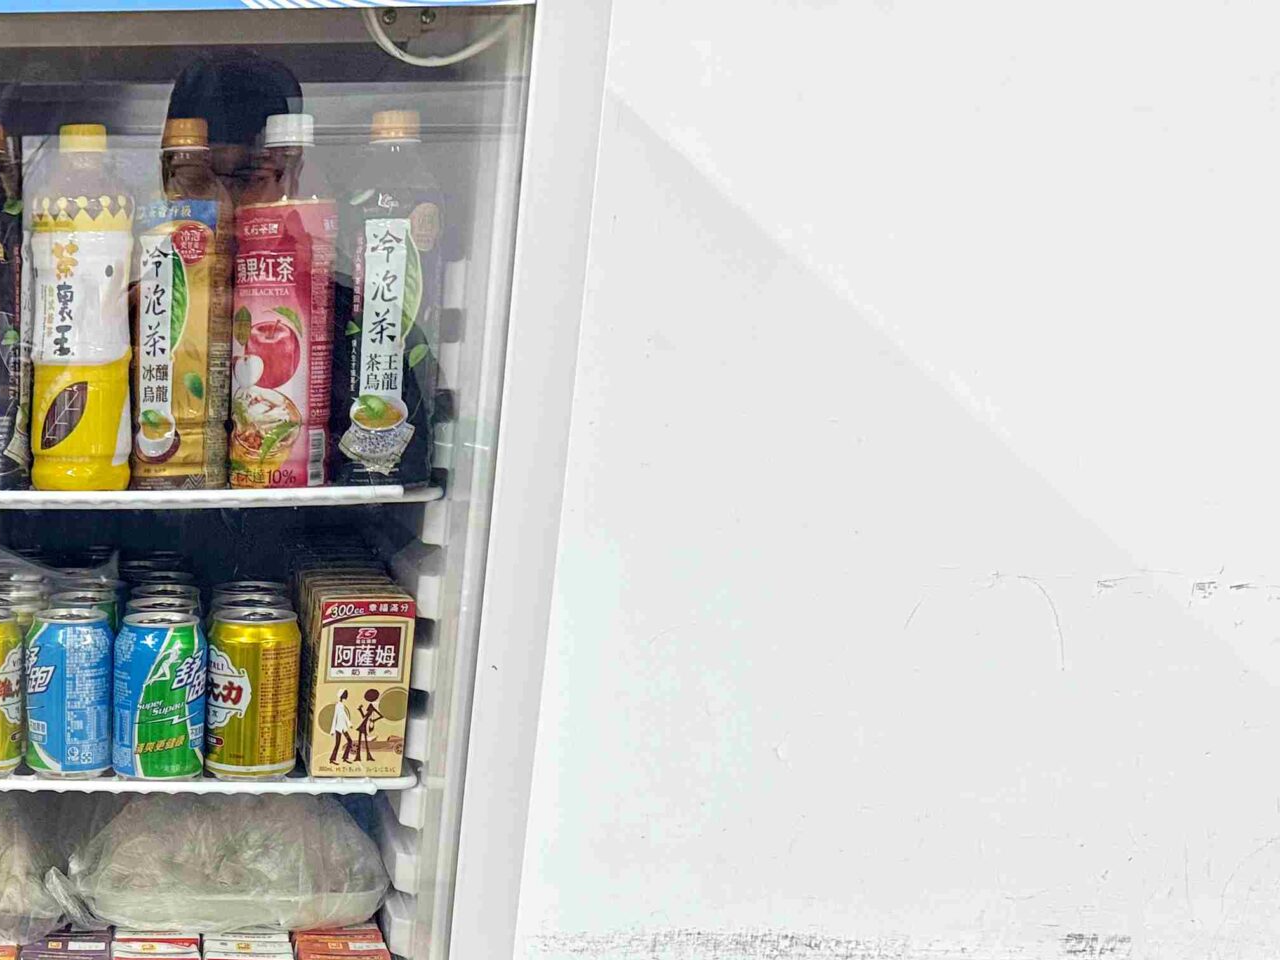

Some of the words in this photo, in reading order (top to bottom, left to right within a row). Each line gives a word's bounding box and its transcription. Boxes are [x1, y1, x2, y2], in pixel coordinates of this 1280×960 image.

[141, 246, 170, 357] 冷泡茶
[369, 230, 403, 345] 冷泡茶
[334, 645, 396, 667] 阿薩姆
